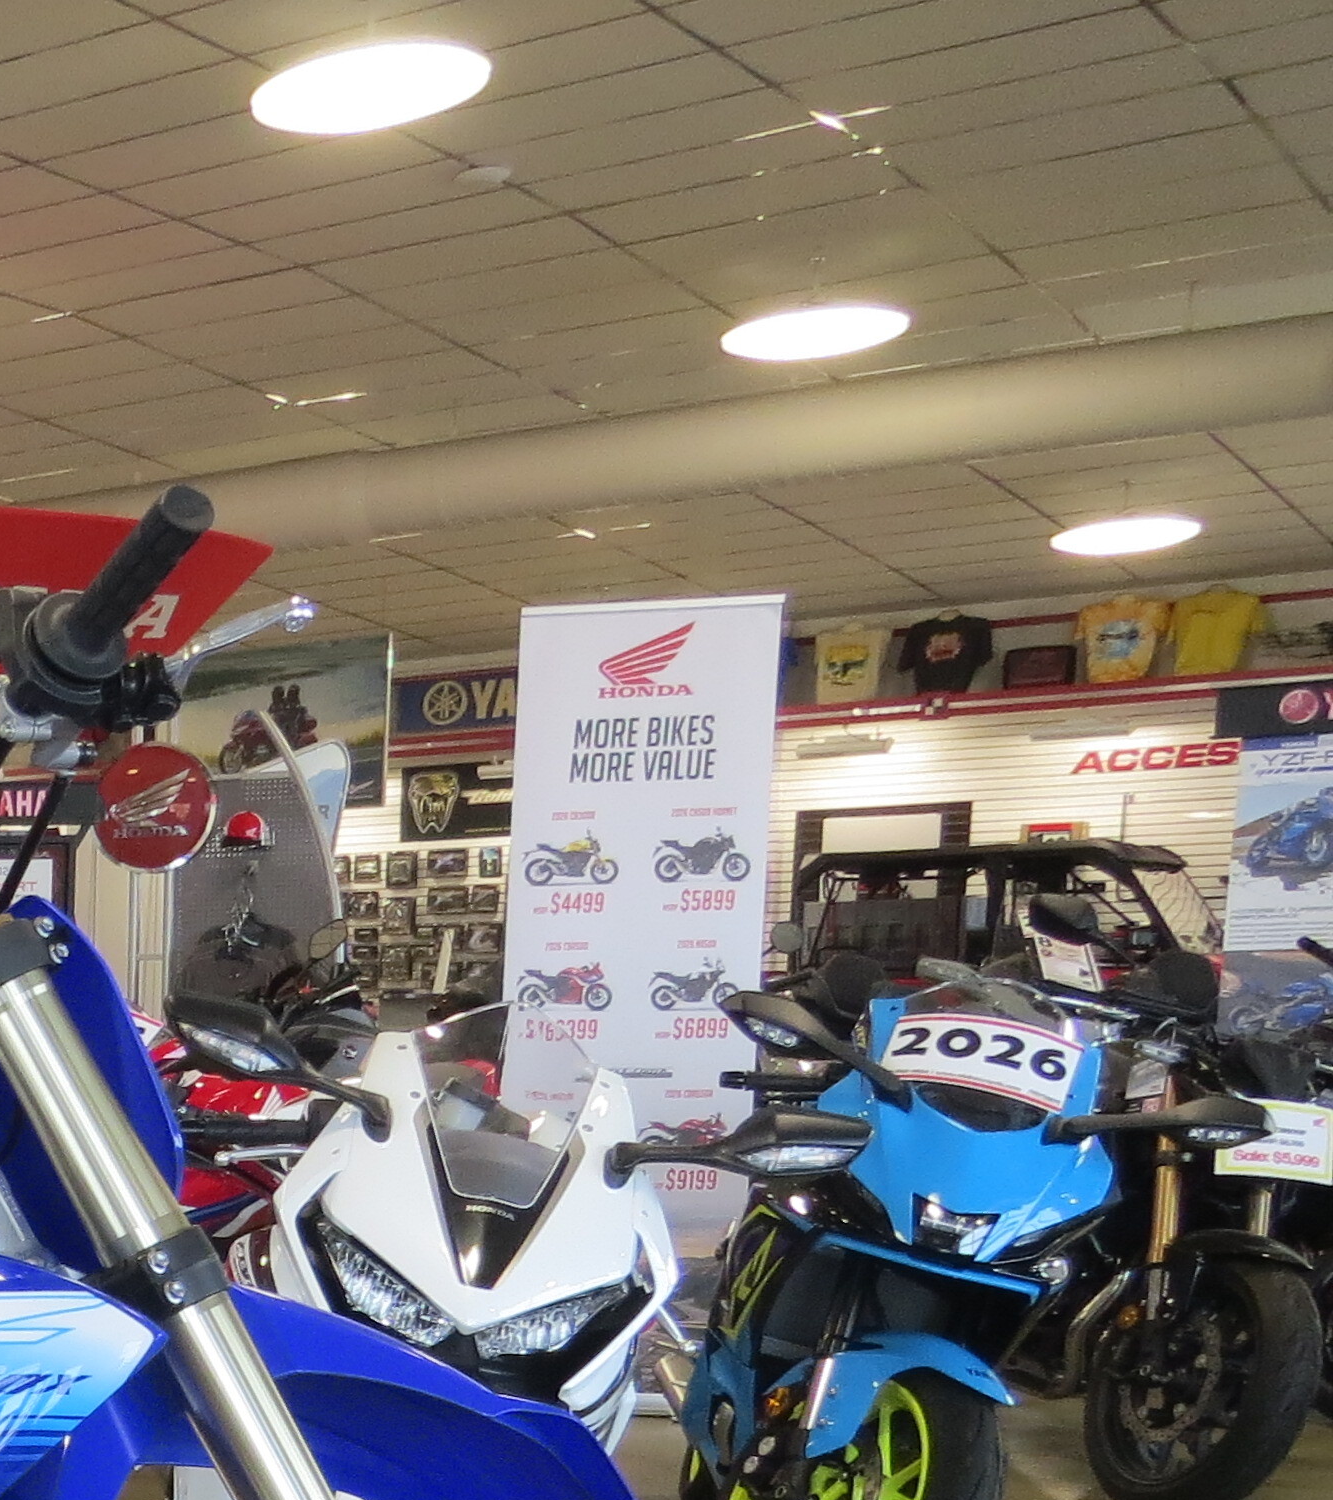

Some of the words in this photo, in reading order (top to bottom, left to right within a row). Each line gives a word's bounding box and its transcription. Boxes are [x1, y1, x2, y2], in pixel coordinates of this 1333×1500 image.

[598, 684, 693, 699] HONDA
[573, 717, 640, 750] MORE
[646, 714, 716, 747] BIKES
[569, 750, 636, 783] MORE
[643, 748, 717, 782] VALUE
[1071, 740, 1241, 774] ACCES
[550, 891, 605, 916] $4499
[680, 888, 736, 914] $5899
[672, 1017, 729, 1041] $6899
[891, 1027, 1067, 1082] 2026
[664, 1167, 719, 1192] $9199
